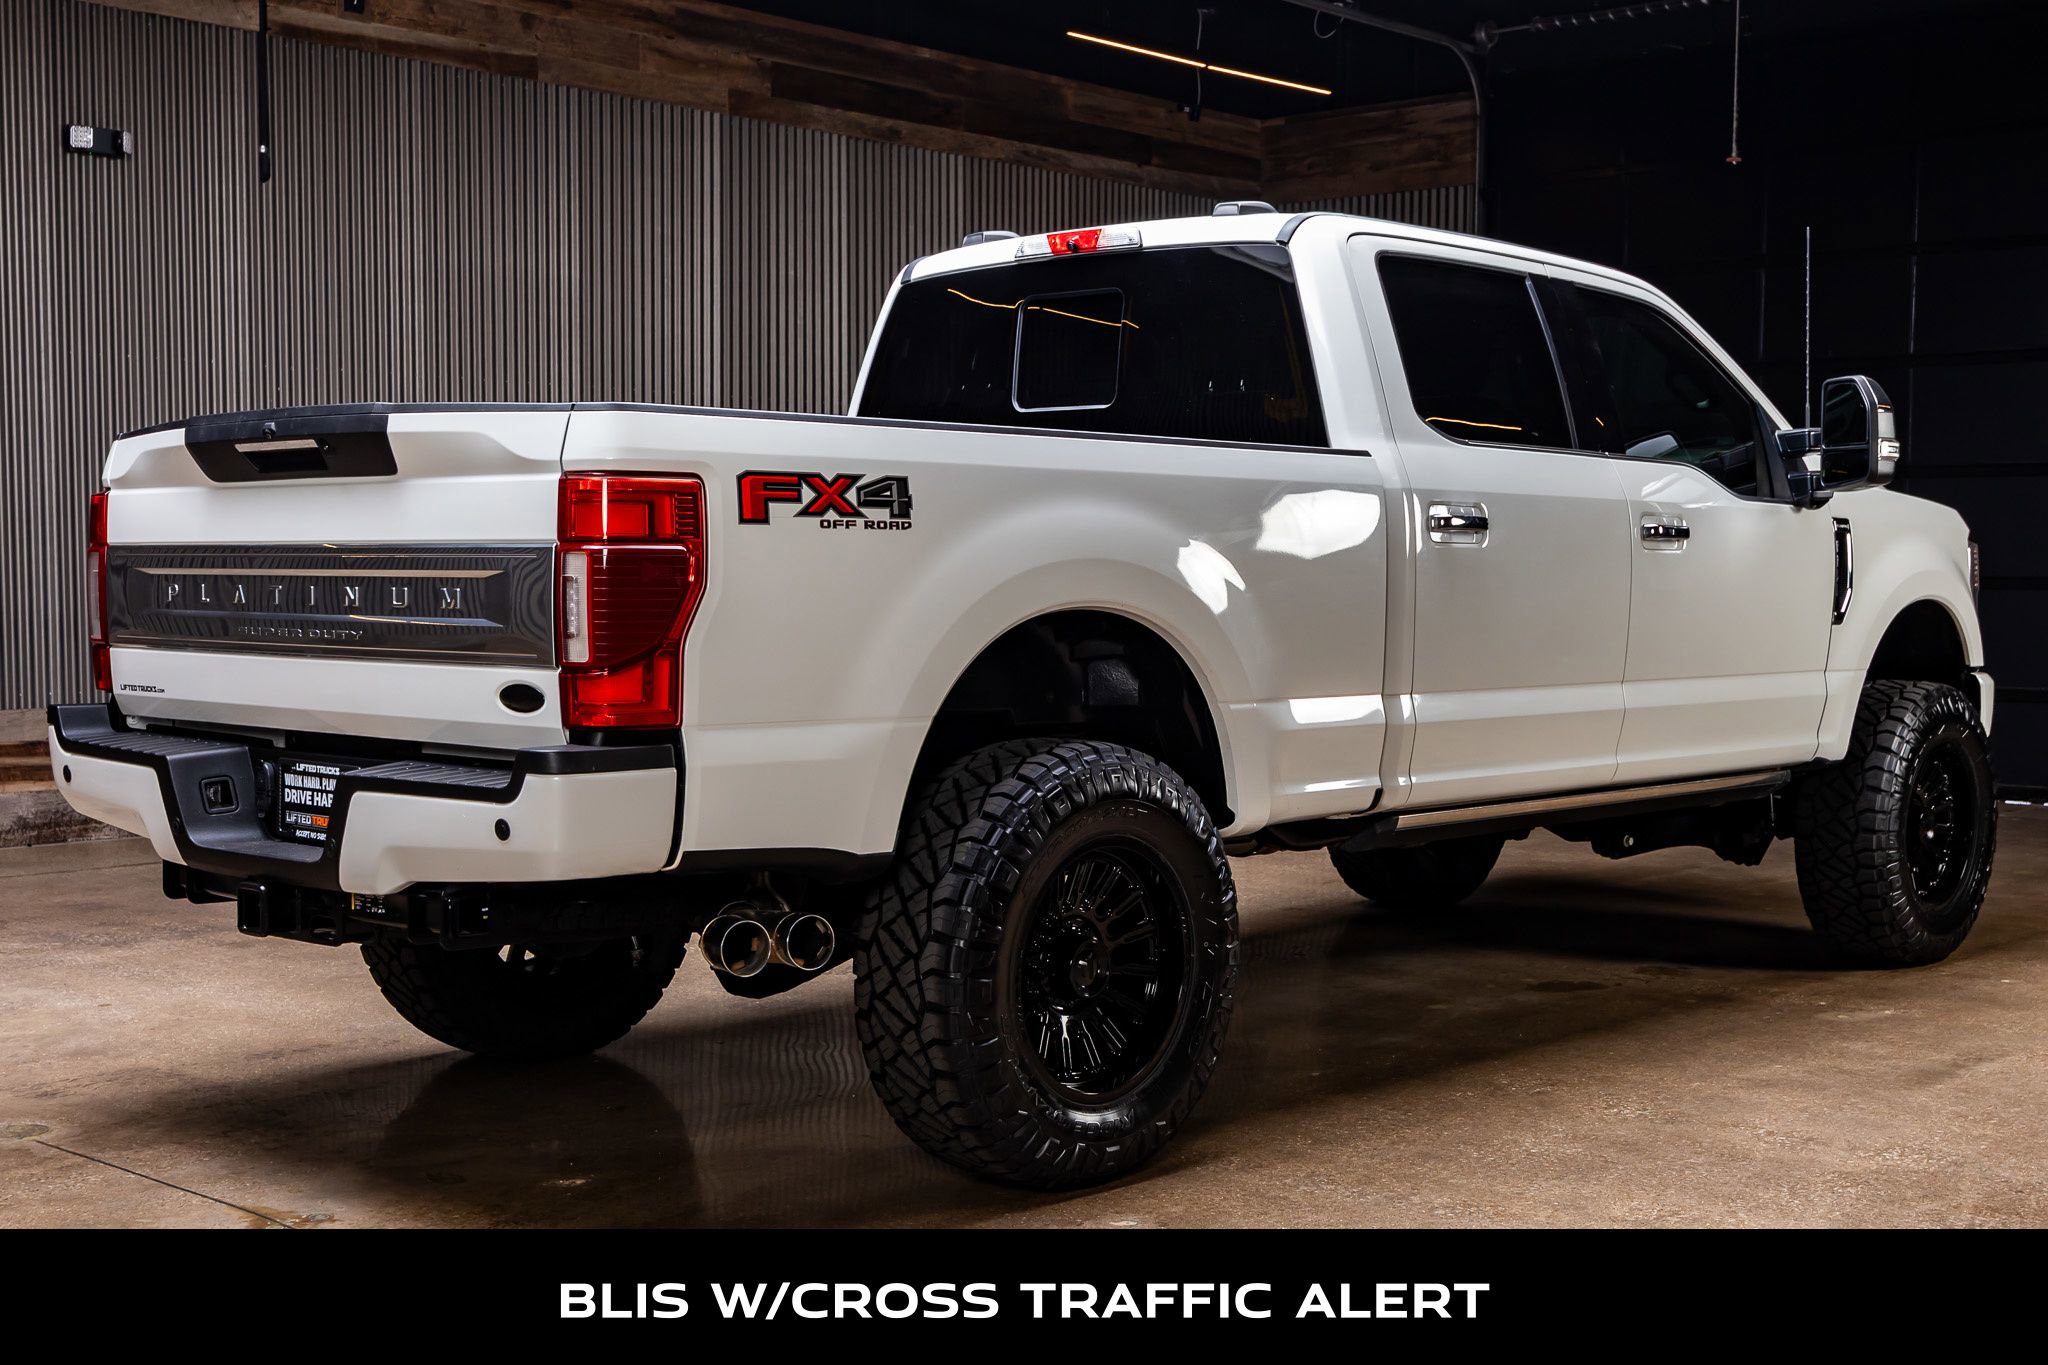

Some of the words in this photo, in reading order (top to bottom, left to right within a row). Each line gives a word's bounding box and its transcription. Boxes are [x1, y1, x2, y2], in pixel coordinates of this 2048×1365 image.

[736, 470, 913, 525] FX4
[819, 519, 857, 530] OFF
[864, 520, 912, 531] ROAD
[166, 583, 462, 609] PLATINUM
[284, 773, 303, 787] WORK
[304, 775, 322, 789] HARD.
[284, 788, 312, 805] DRIVE
[286, 812, 312, 824] LIFTED
